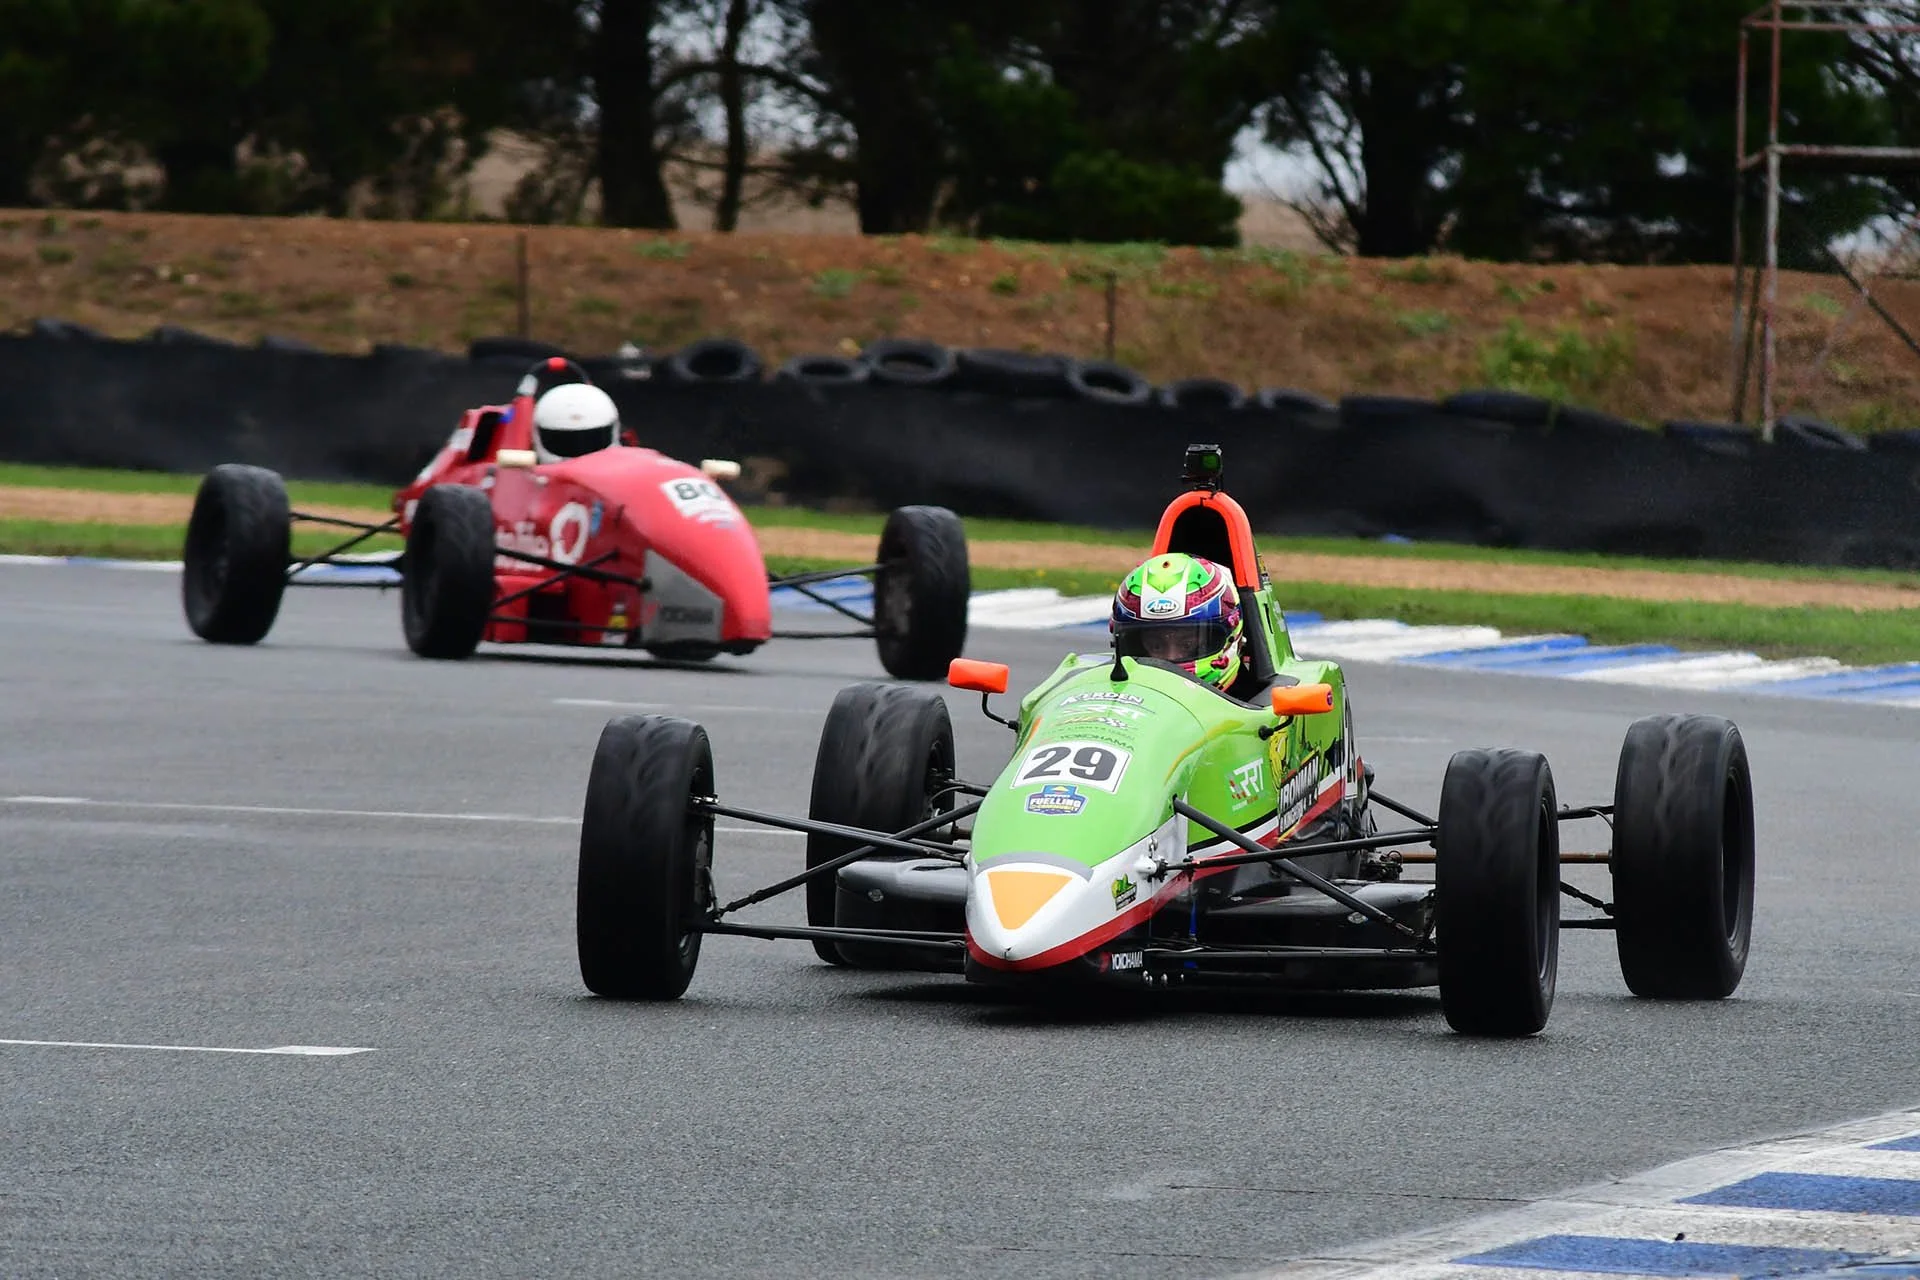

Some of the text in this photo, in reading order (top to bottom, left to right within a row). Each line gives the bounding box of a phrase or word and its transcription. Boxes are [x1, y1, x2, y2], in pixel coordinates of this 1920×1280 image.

[1149, 599, 1176, 611] Arai
[1023, 746, 1117, 781] 29
[1280, 755, 1319, 816] IRONMAN
[1030, 797, 1081, 807] FUELLING
[1111, 951, 1143, 970] YOKOHAMA
